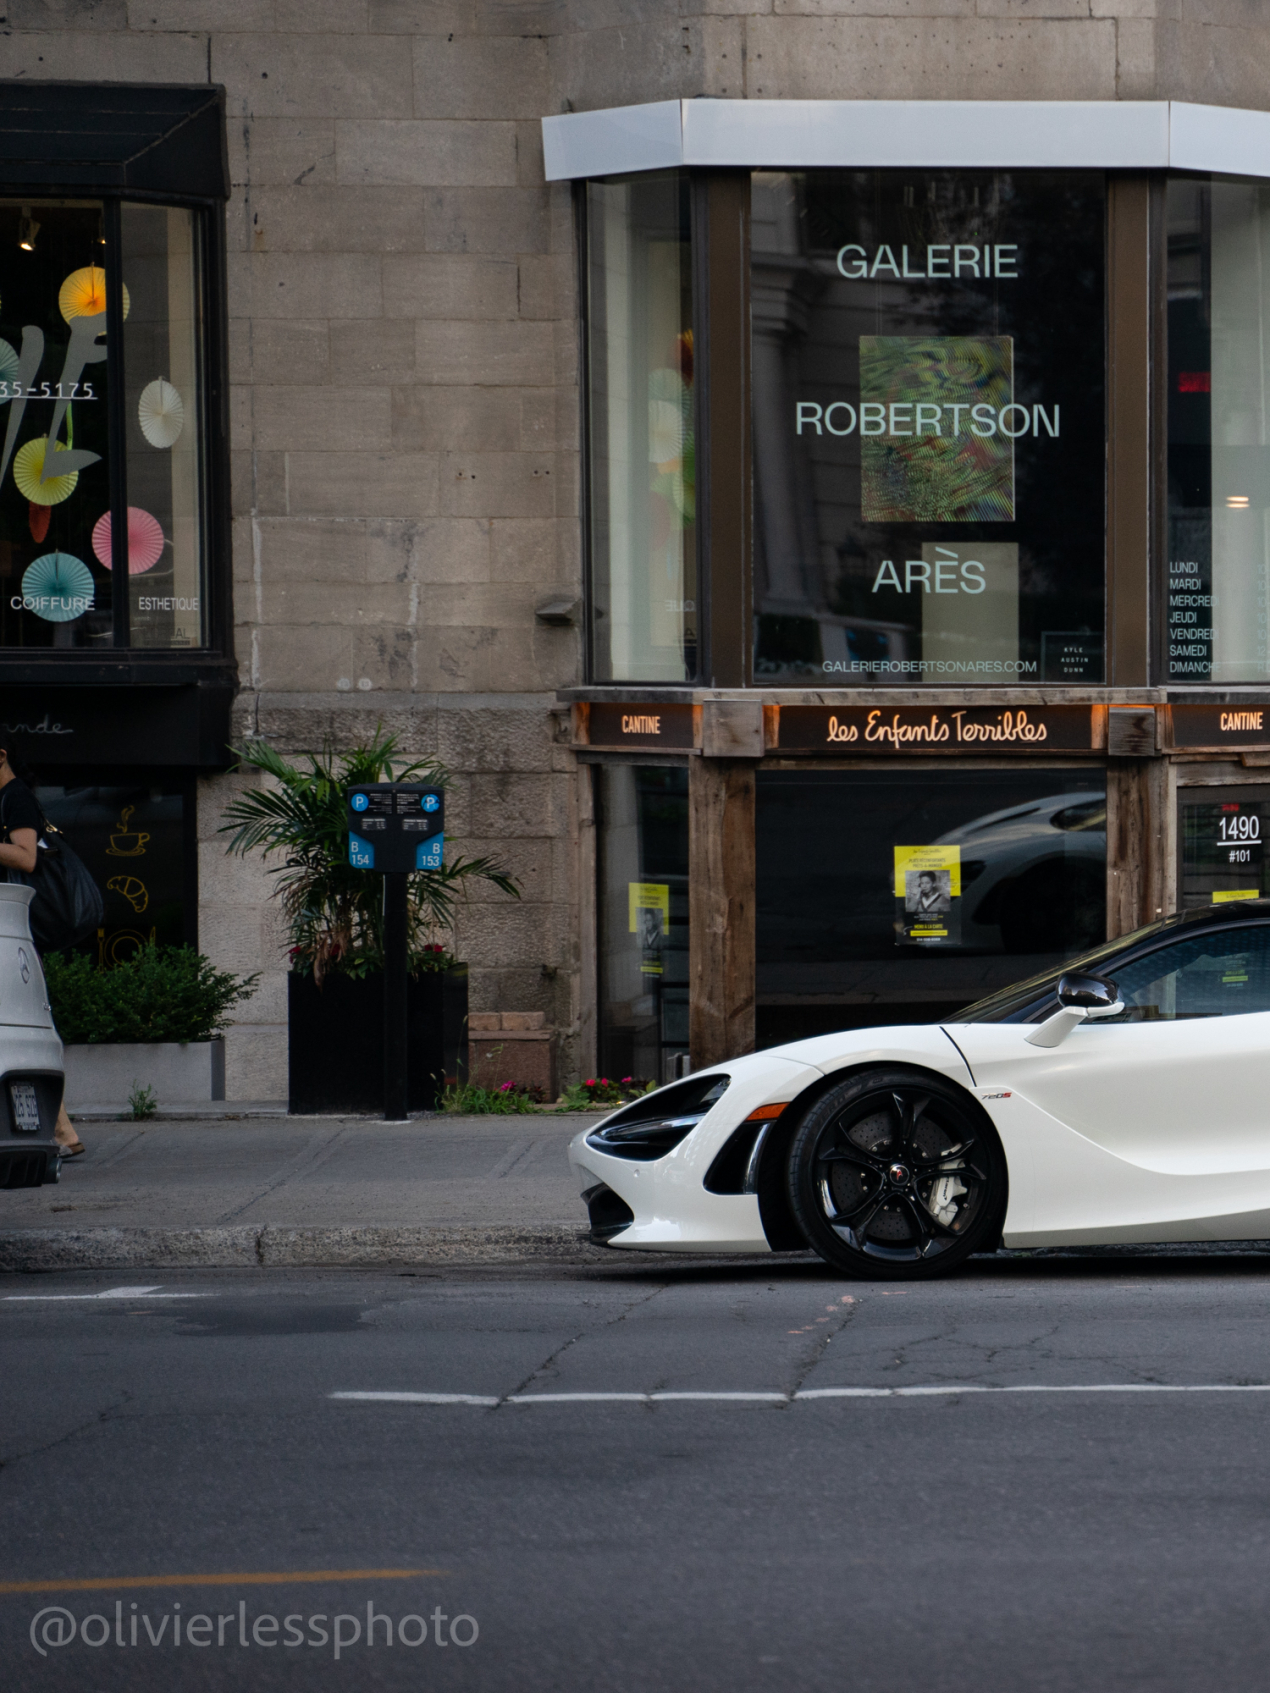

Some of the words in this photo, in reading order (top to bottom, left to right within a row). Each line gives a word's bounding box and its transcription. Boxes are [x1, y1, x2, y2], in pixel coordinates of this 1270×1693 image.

[837, 244, 1018, 278] GALERIE
[796, 402, 1060, 437] ROBERTSON
[871, 546, 986, 594] ARÈS
[1169, 562, 1198, 573] LUNDI
[1169, 579, 1202, 590] MARDI
[10, 596, 96, 611] COIFFURE
[138, 596, 200, 611] ESTHETIQUE
[1169, 612, 1197, 623] JEUDI
[1169, 645, 1207, 656] SAMEDI
[822, 661, 1037, 673] GALERIEROBERTSONARES.COM
[1169, 661, 1221, 673] DIMANCHE
[621, 715, 661, 734] CANTINE
[1220, 712, 1264, 731] CANTINE
[826, 716, 859, 742] les
[864, 710, 949, 749] Enfants
[951, 710, 1048, 742] Terribles
[1219, 815, 1260, 841] 1490
[351, 841, 359, 853] B
[433, 843, 440, 854] B
[352, 854, 369, 865] 154
[422, 855, 440, 866] 153
[1228, 850, 1251, 863] #101
[981, 1092, 1012, 1100] 720S
